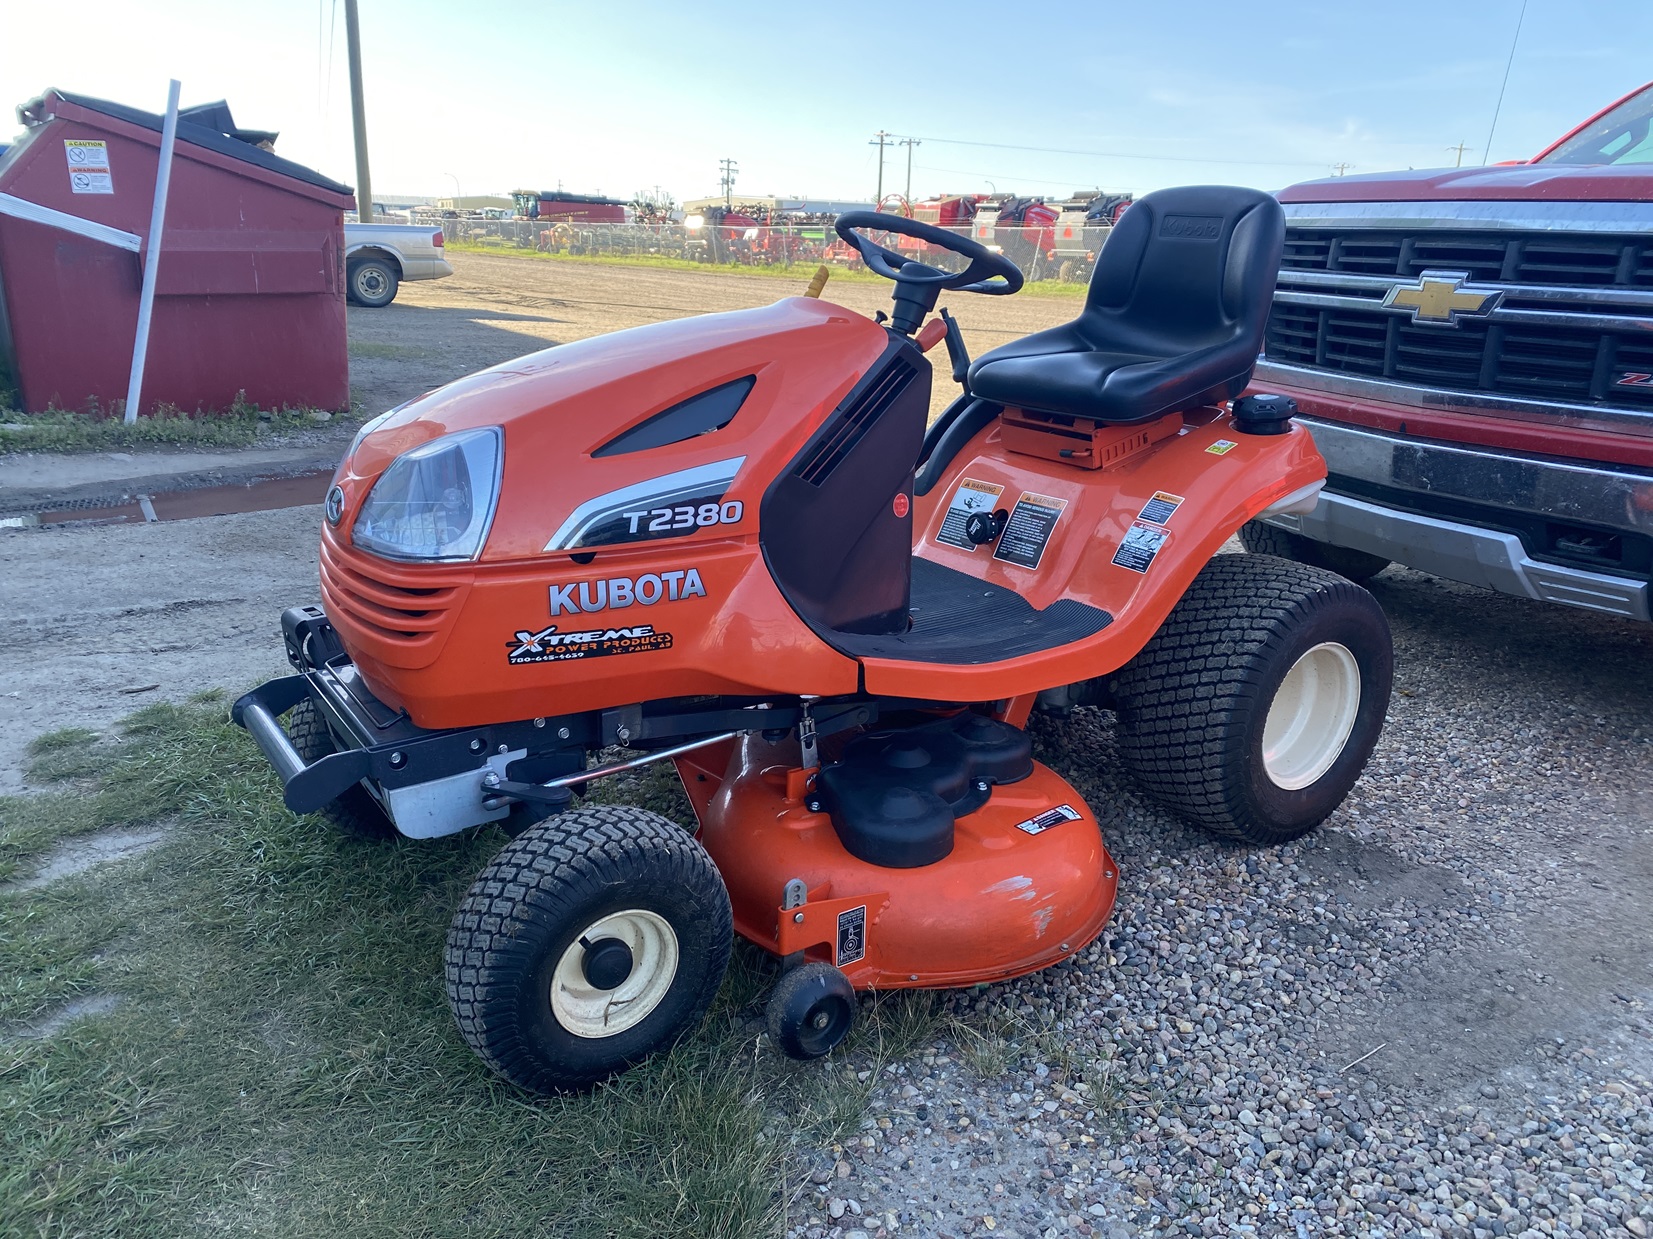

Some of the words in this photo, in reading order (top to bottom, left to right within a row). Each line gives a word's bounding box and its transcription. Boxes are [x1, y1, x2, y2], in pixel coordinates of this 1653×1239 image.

[971, 482, 997, 493] WARNING
[1033, 497, 1061, 507] WARNING
[623, 501, 743, 533] T2380
[549, 568, 707, 616] KUBOTA
[510, 626, 654, 657] XTREME
[546, 643, 598, 654] POWER
[603, 634, 672, 649] PRODUCTS
